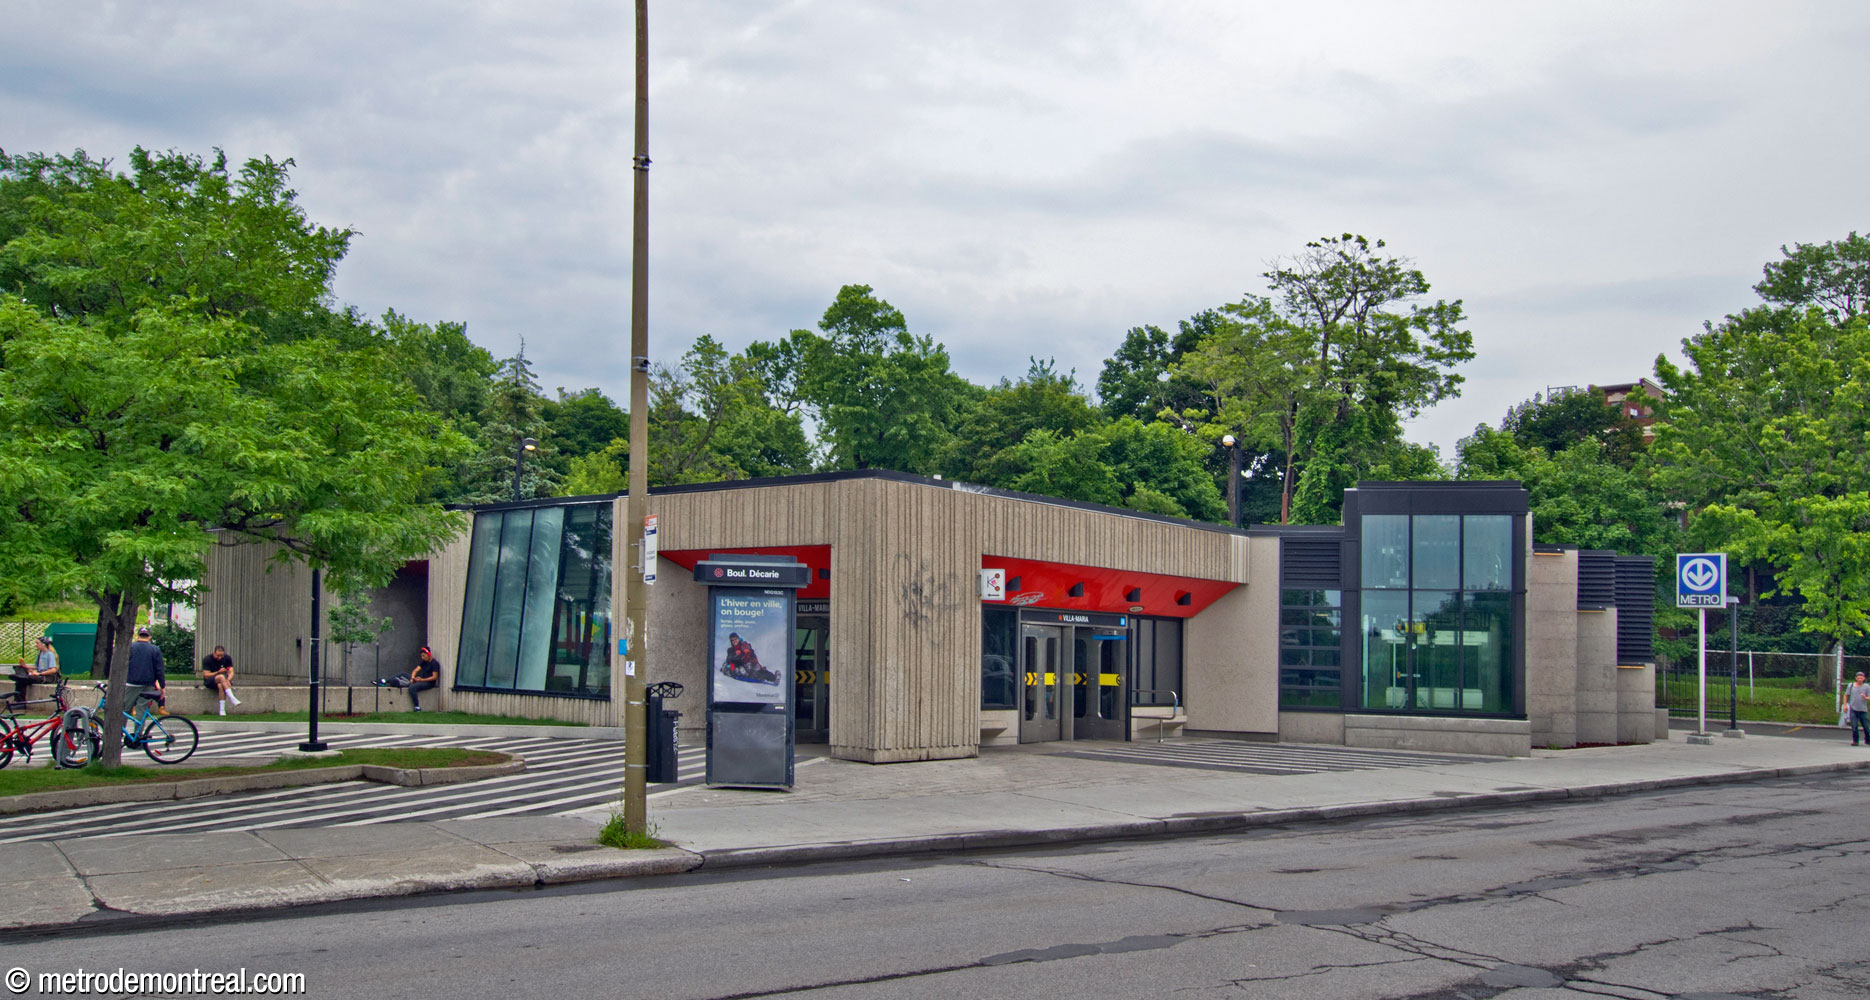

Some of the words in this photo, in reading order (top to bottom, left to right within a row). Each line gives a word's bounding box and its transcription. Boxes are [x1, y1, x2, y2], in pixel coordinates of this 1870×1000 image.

[727, 568, 747, 577] Boul.
[749, 569, 779, 578] Décarie
[720, 599, 748, 608] L'hiver
[763, 600, 782, 609] ville,
[1680, 594, 1720, 605] METRO
[734, 608, 764, 617] bouge!
[1062, 614, 1089, 623] VILLA-MARIA
